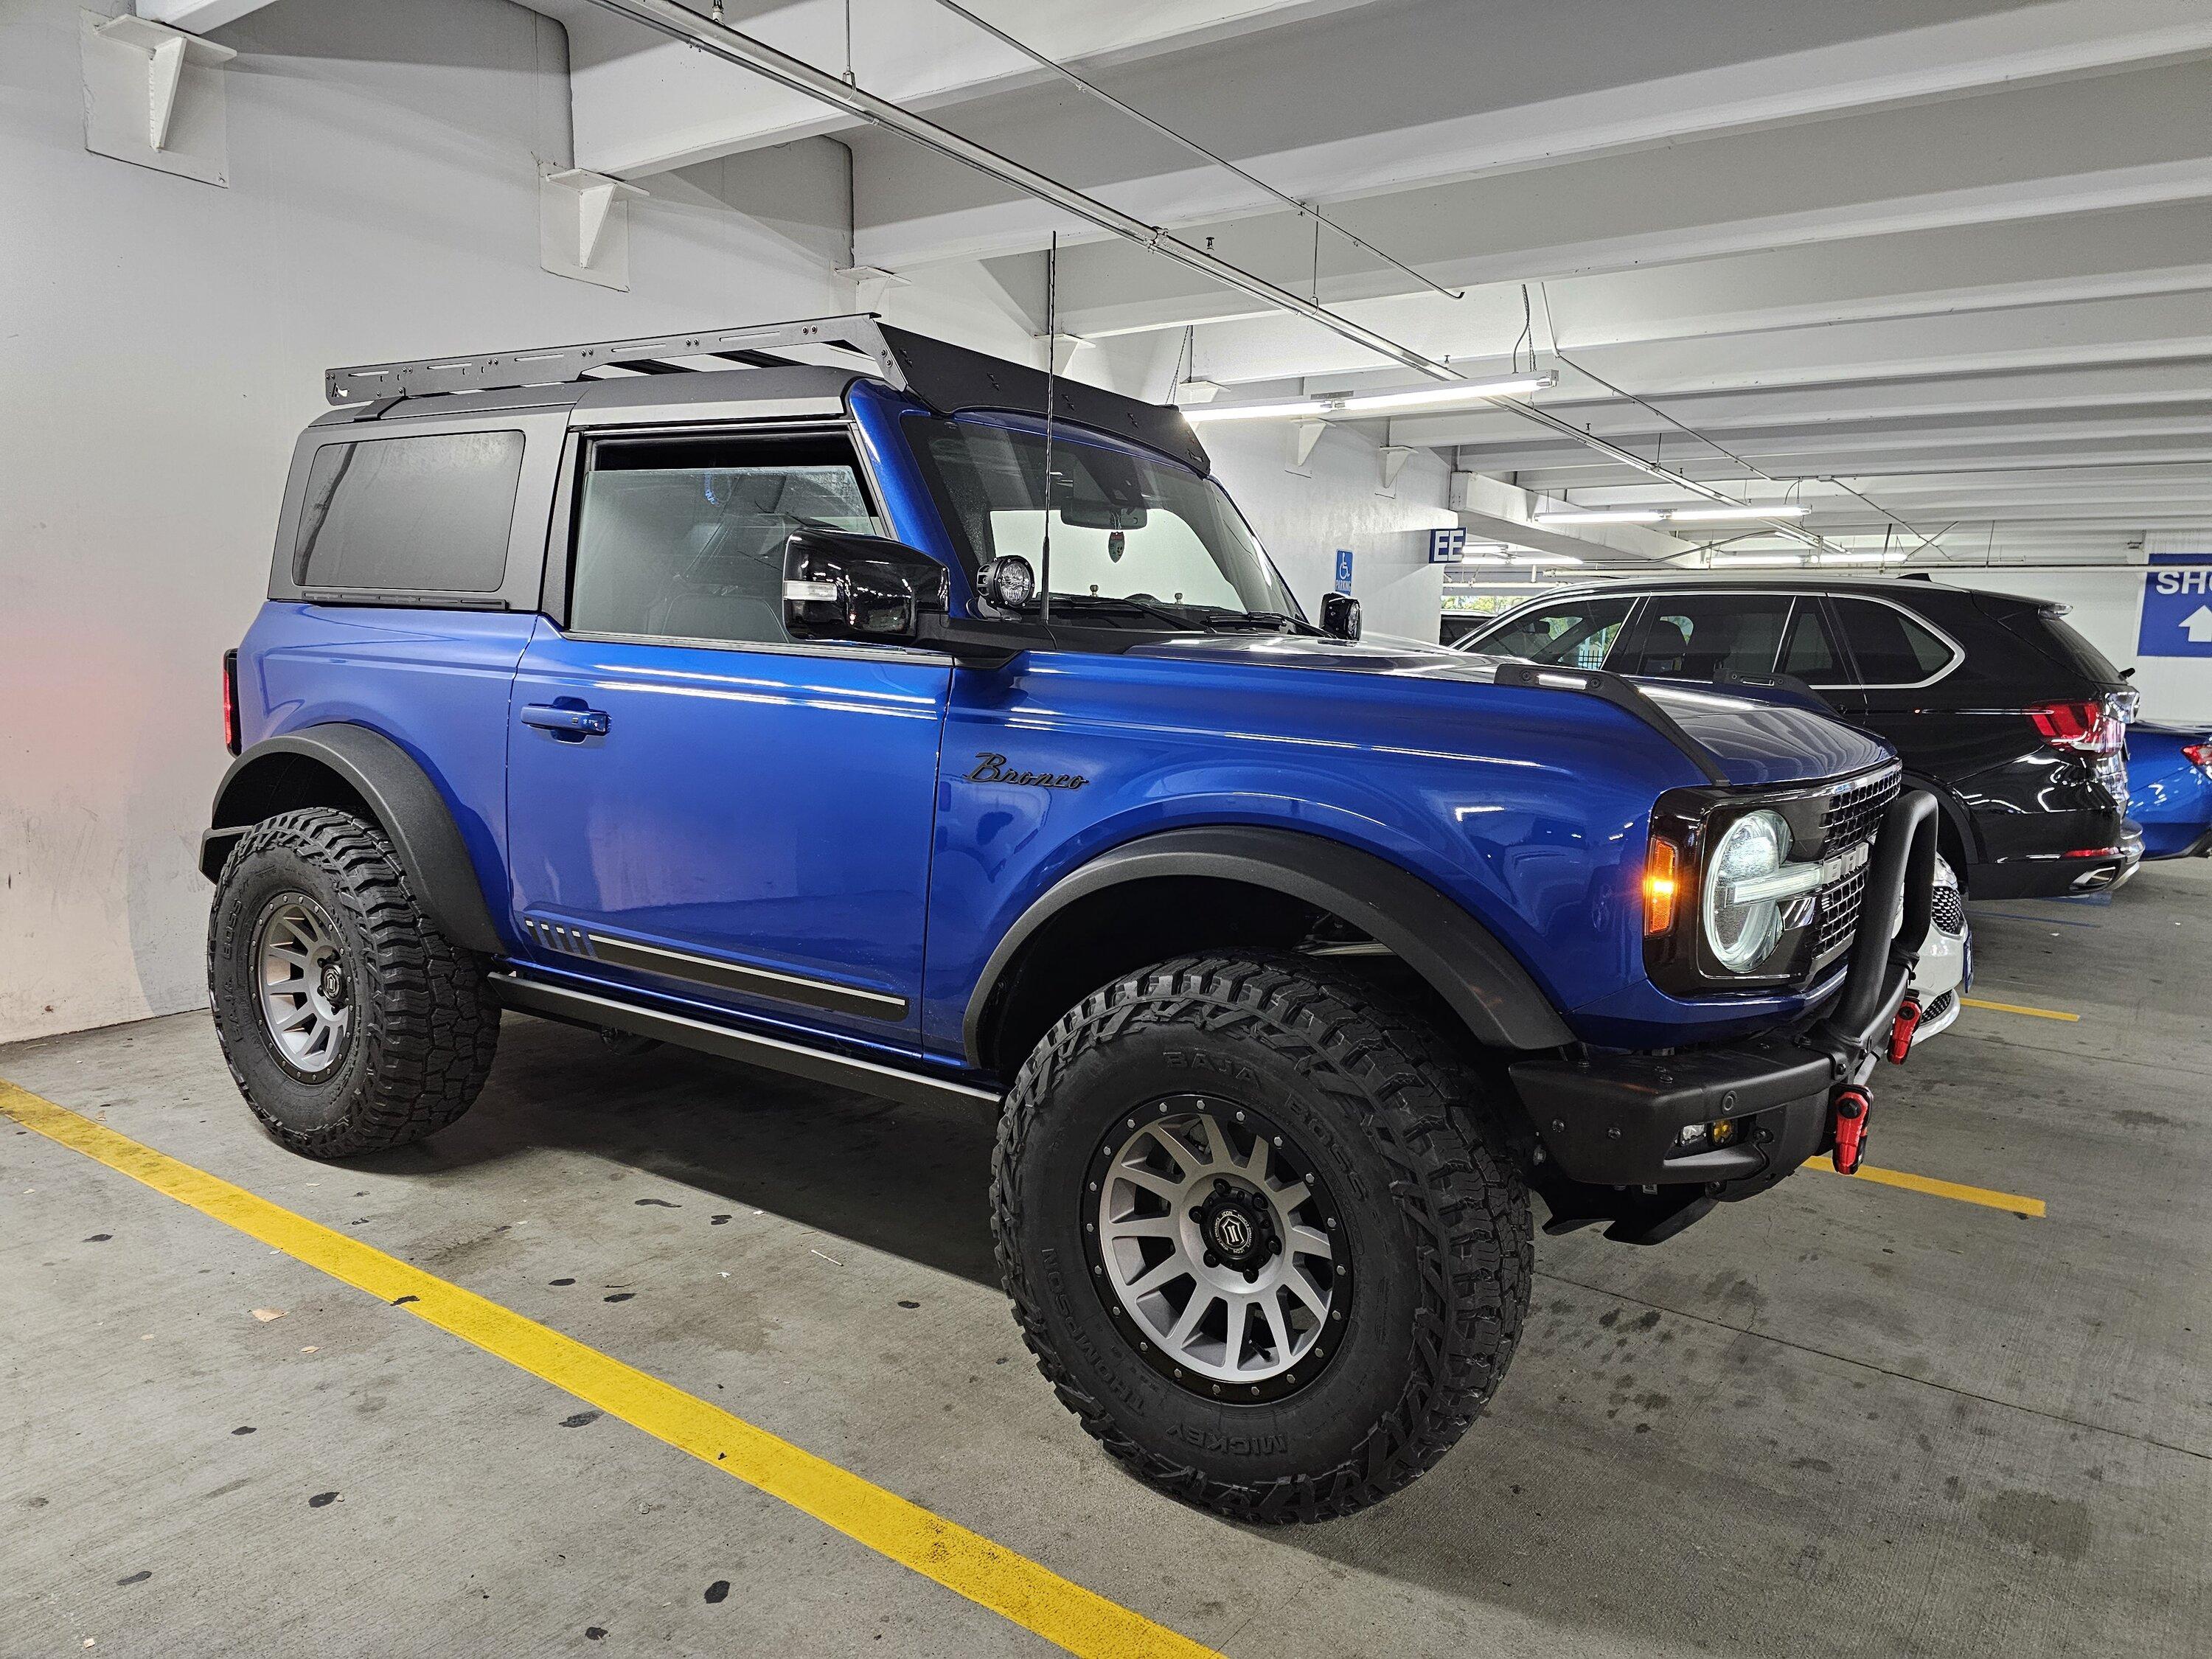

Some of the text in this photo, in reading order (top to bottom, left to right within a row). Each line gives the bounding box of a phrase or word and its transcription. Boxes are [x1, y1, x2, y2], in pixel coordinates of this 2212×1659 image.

[1434, 530, 1464, 561] EE
[2156, 571, 2212, 594] SH
[962, 752, 1090, 790] Bronco
[1162, 1050, 1262, 1089] BAJA
[1040, 1245, 1146, 1416] THOMPSON
[1164, 1422, 1289, 1456] MICKEY
